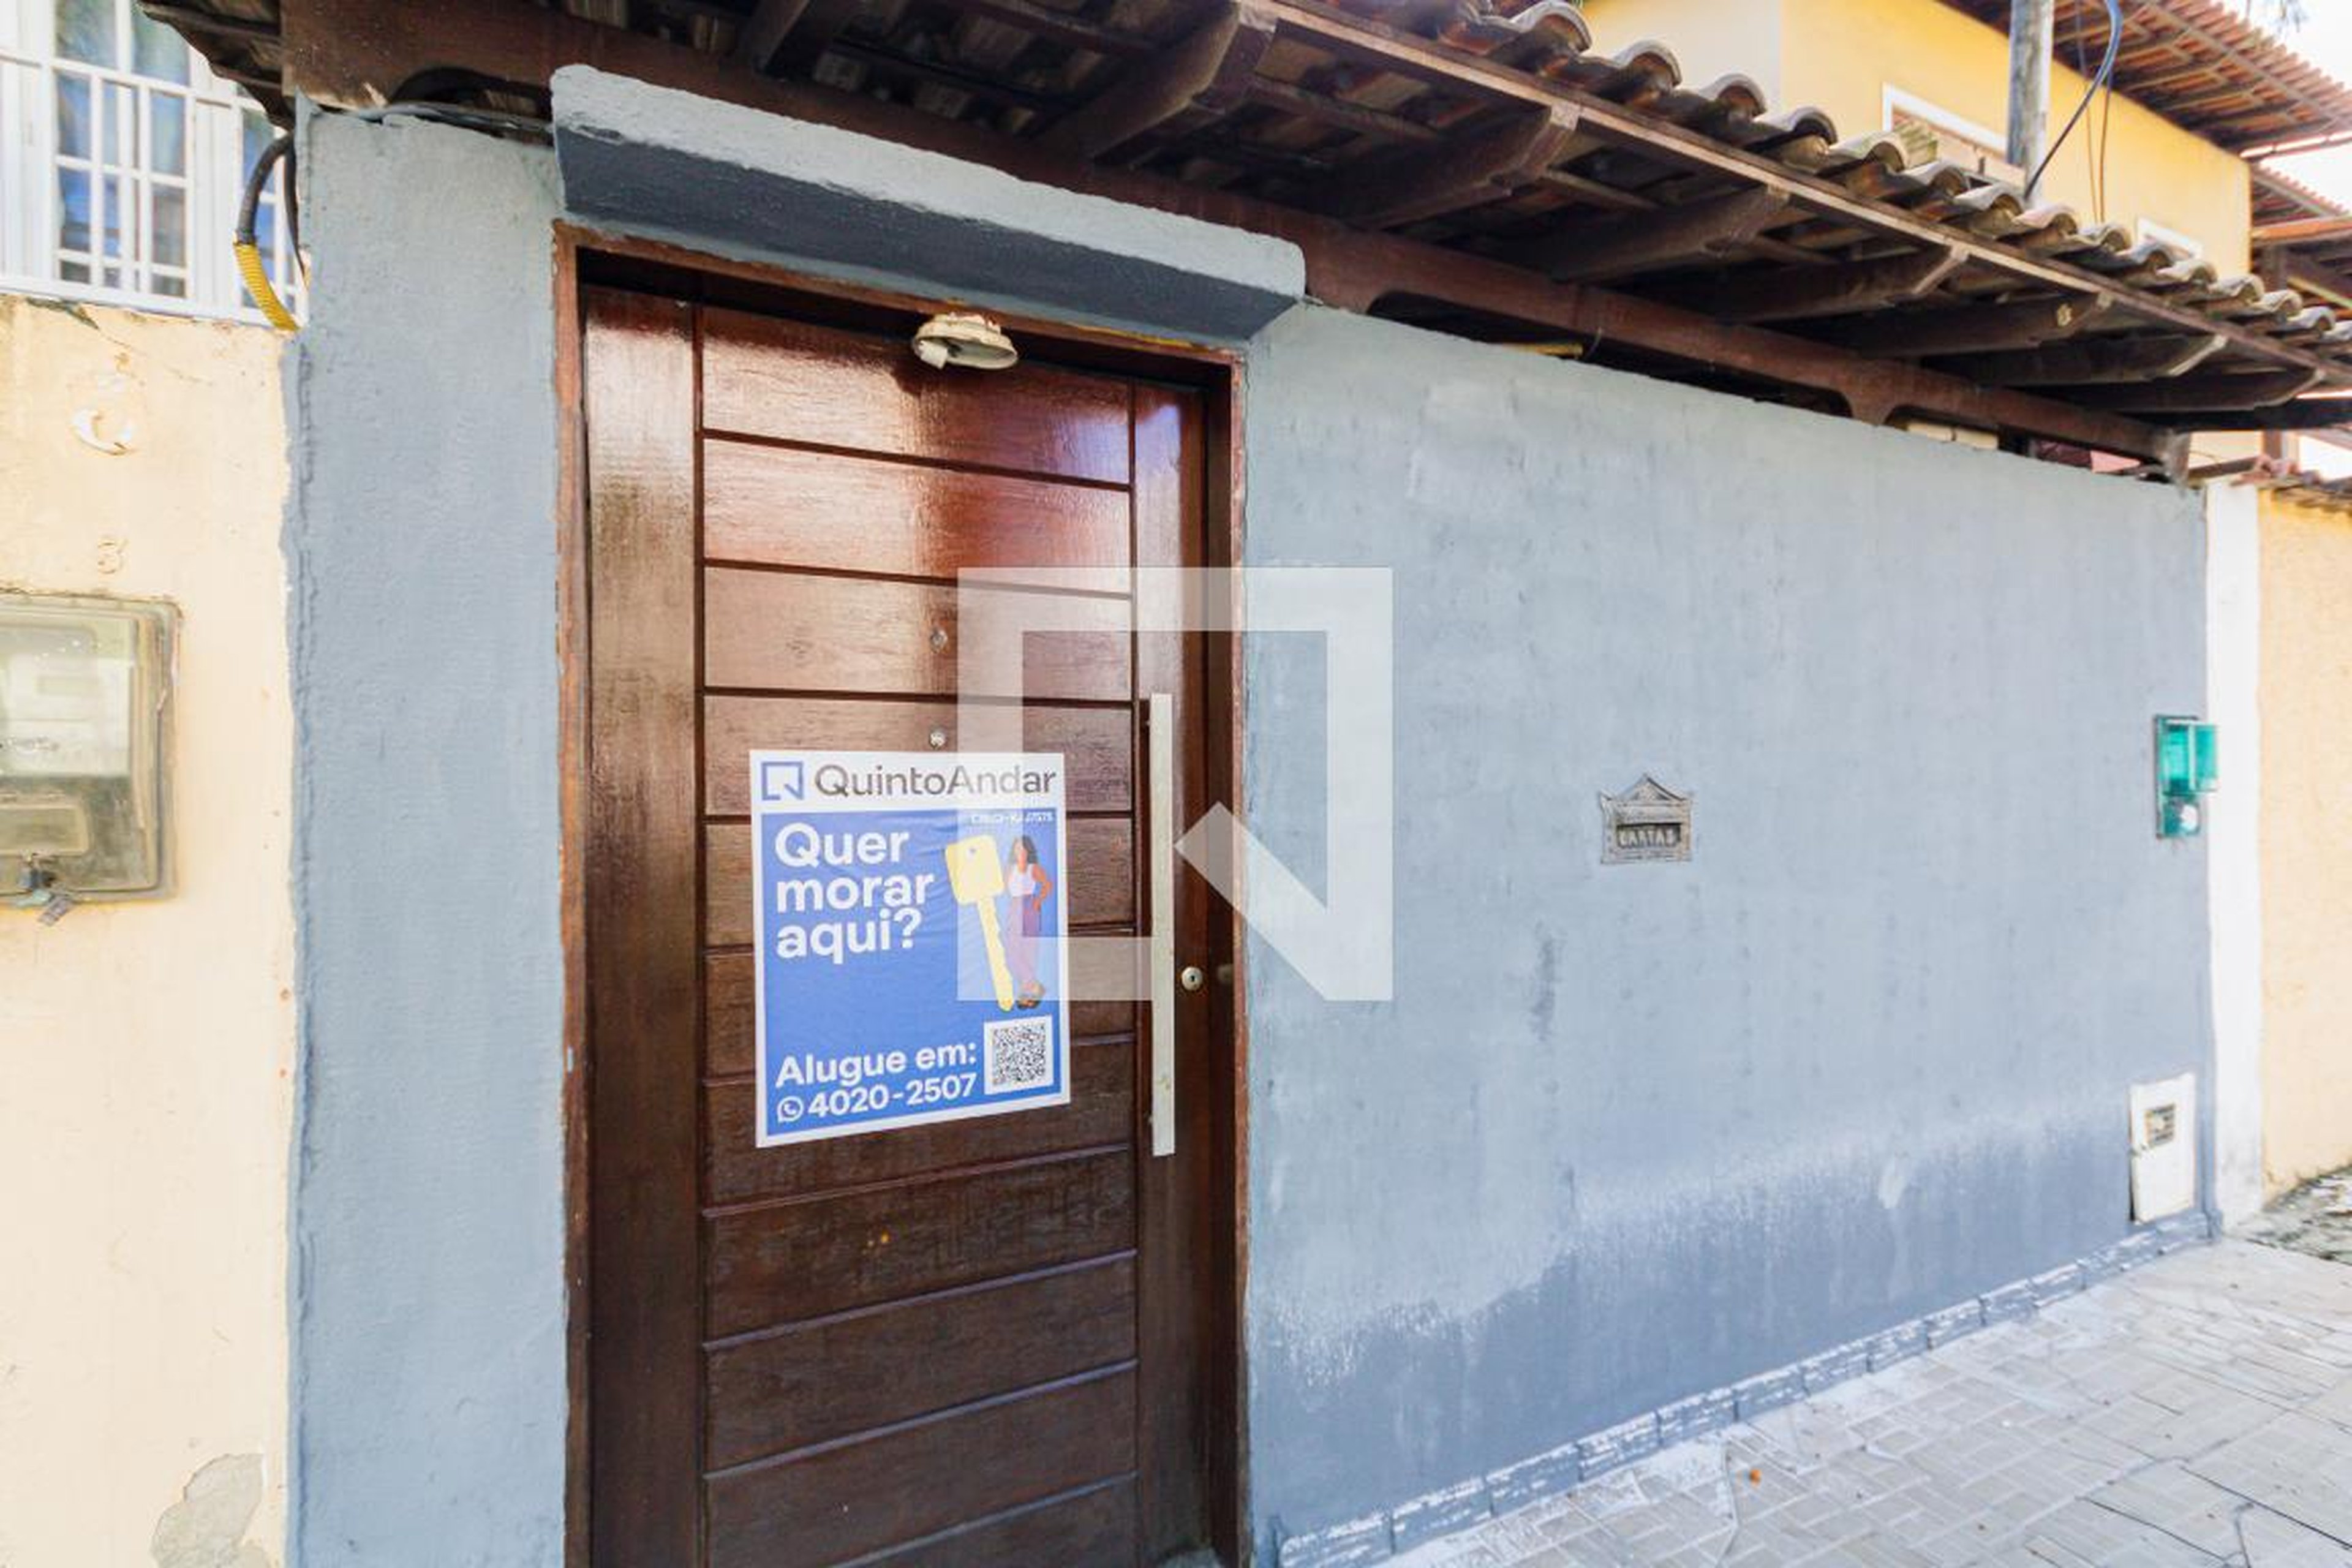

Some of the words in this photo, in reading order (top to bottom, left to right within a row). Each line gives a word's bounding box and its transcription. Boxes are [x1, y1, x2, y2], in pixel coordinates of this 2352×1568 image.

[815, 764, 1057, 797] QuintoAndar
[775, 823, 909, 867] Quer
[777, 873, 935, 913] morar
[777, 908, 921, 964] aqui?
[775, 1050, 906, 1087] Alugue
[915, 1042, 976, 1070] em:
[808, 1072, 978, 1118] 4020-2507
